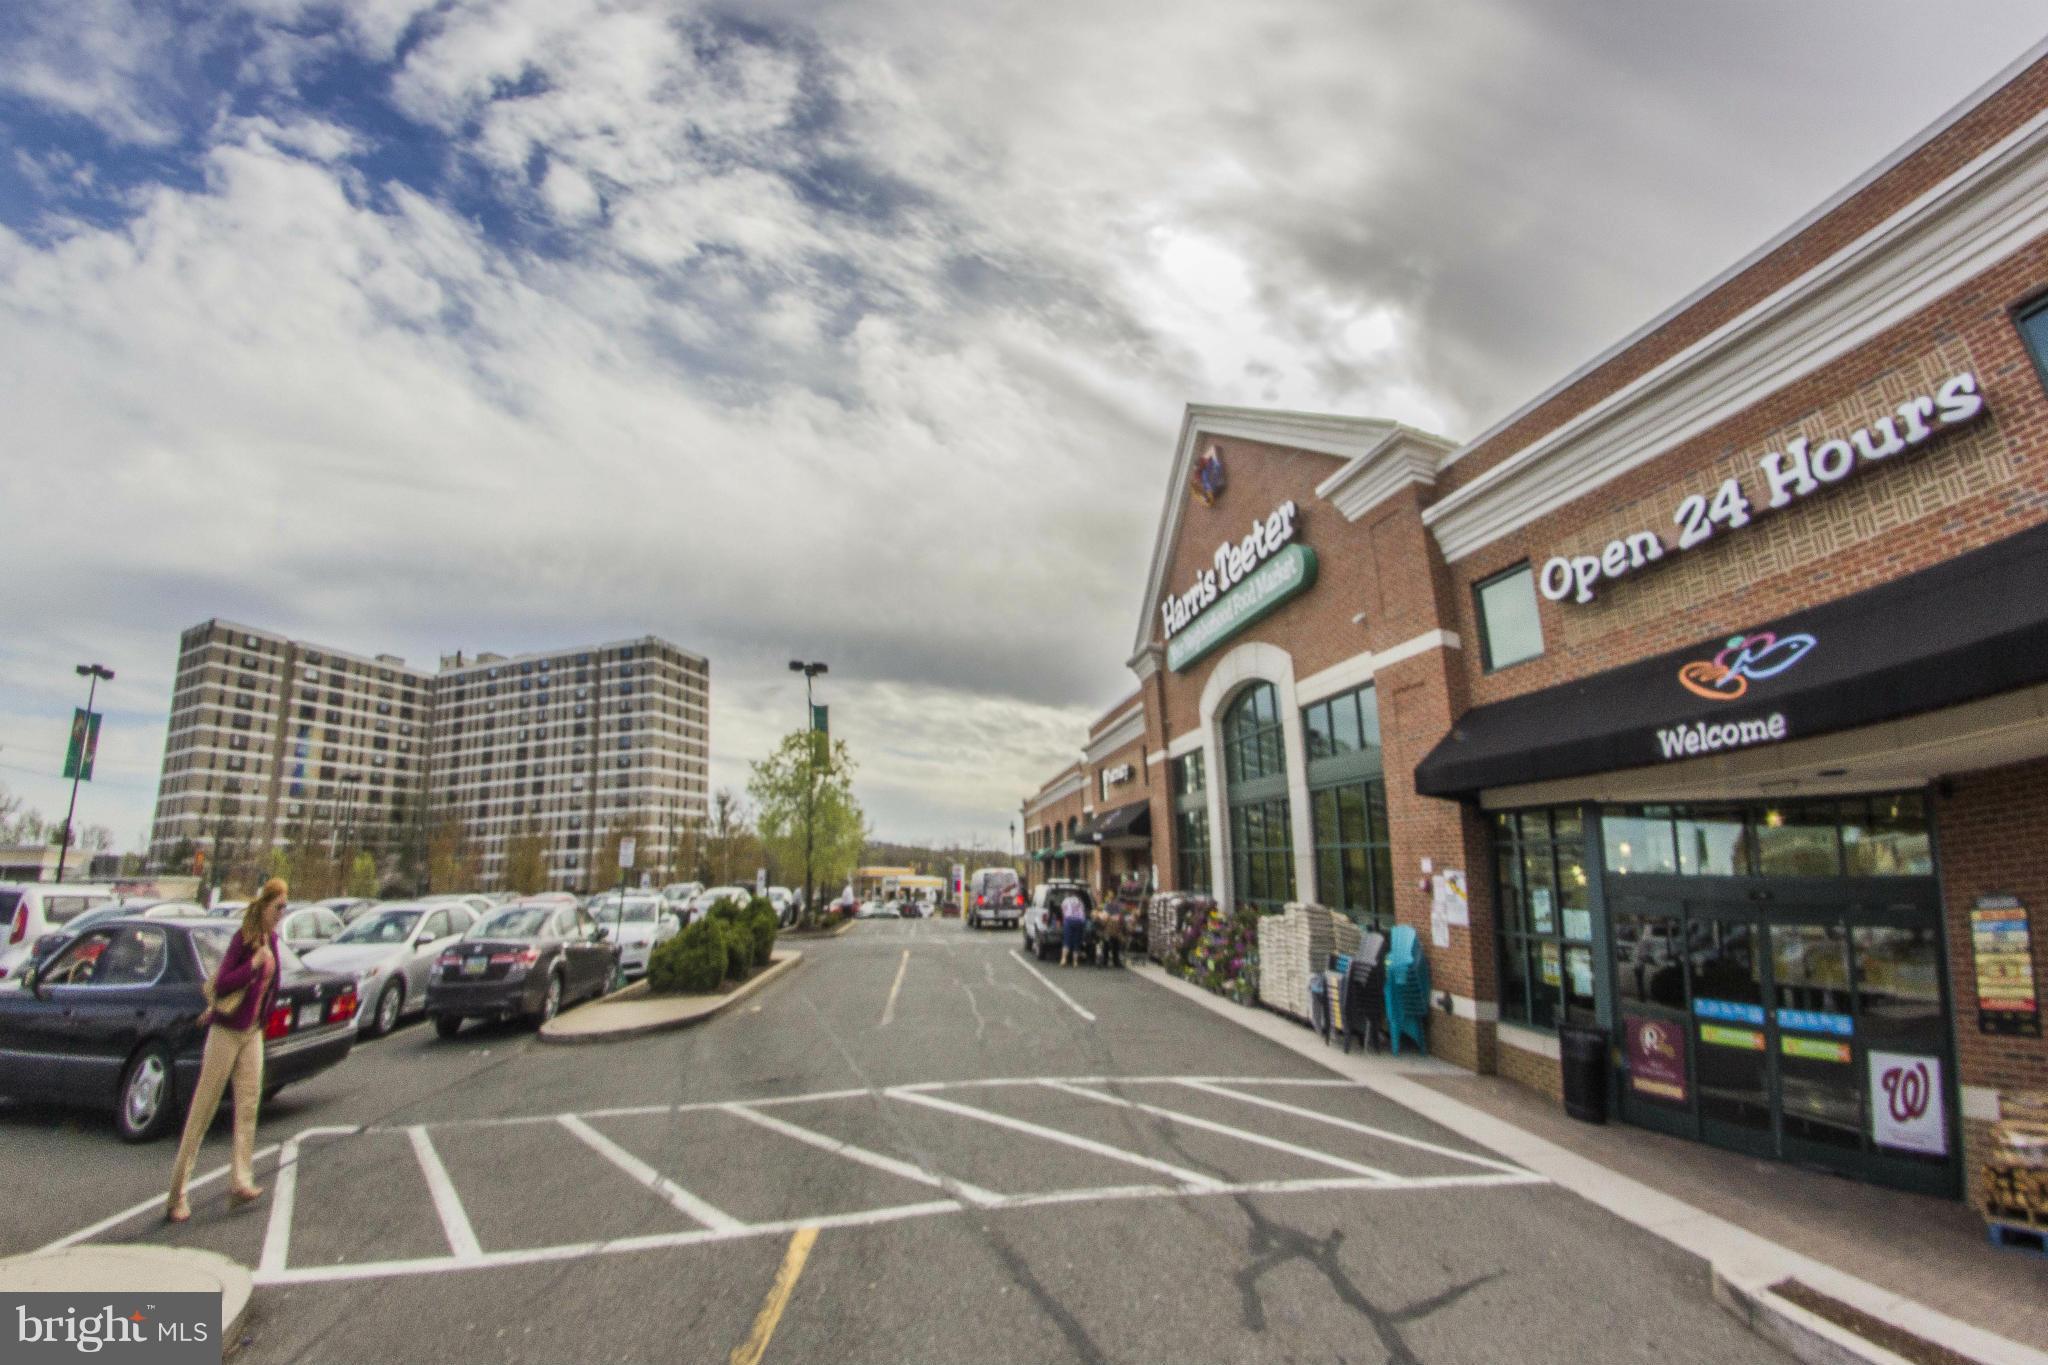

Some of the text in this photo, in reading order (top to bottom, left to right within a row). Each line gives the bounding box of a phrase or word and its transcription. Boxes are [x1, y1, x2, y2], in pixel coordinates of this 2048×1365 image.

[1539, 371, 1982, 604] Open 24 Hours
[1161, 568, 1217, 640] Harris
[1213, 499, 1296, 592] Teeter
[1656, 713, 1787, 758] Welcome
